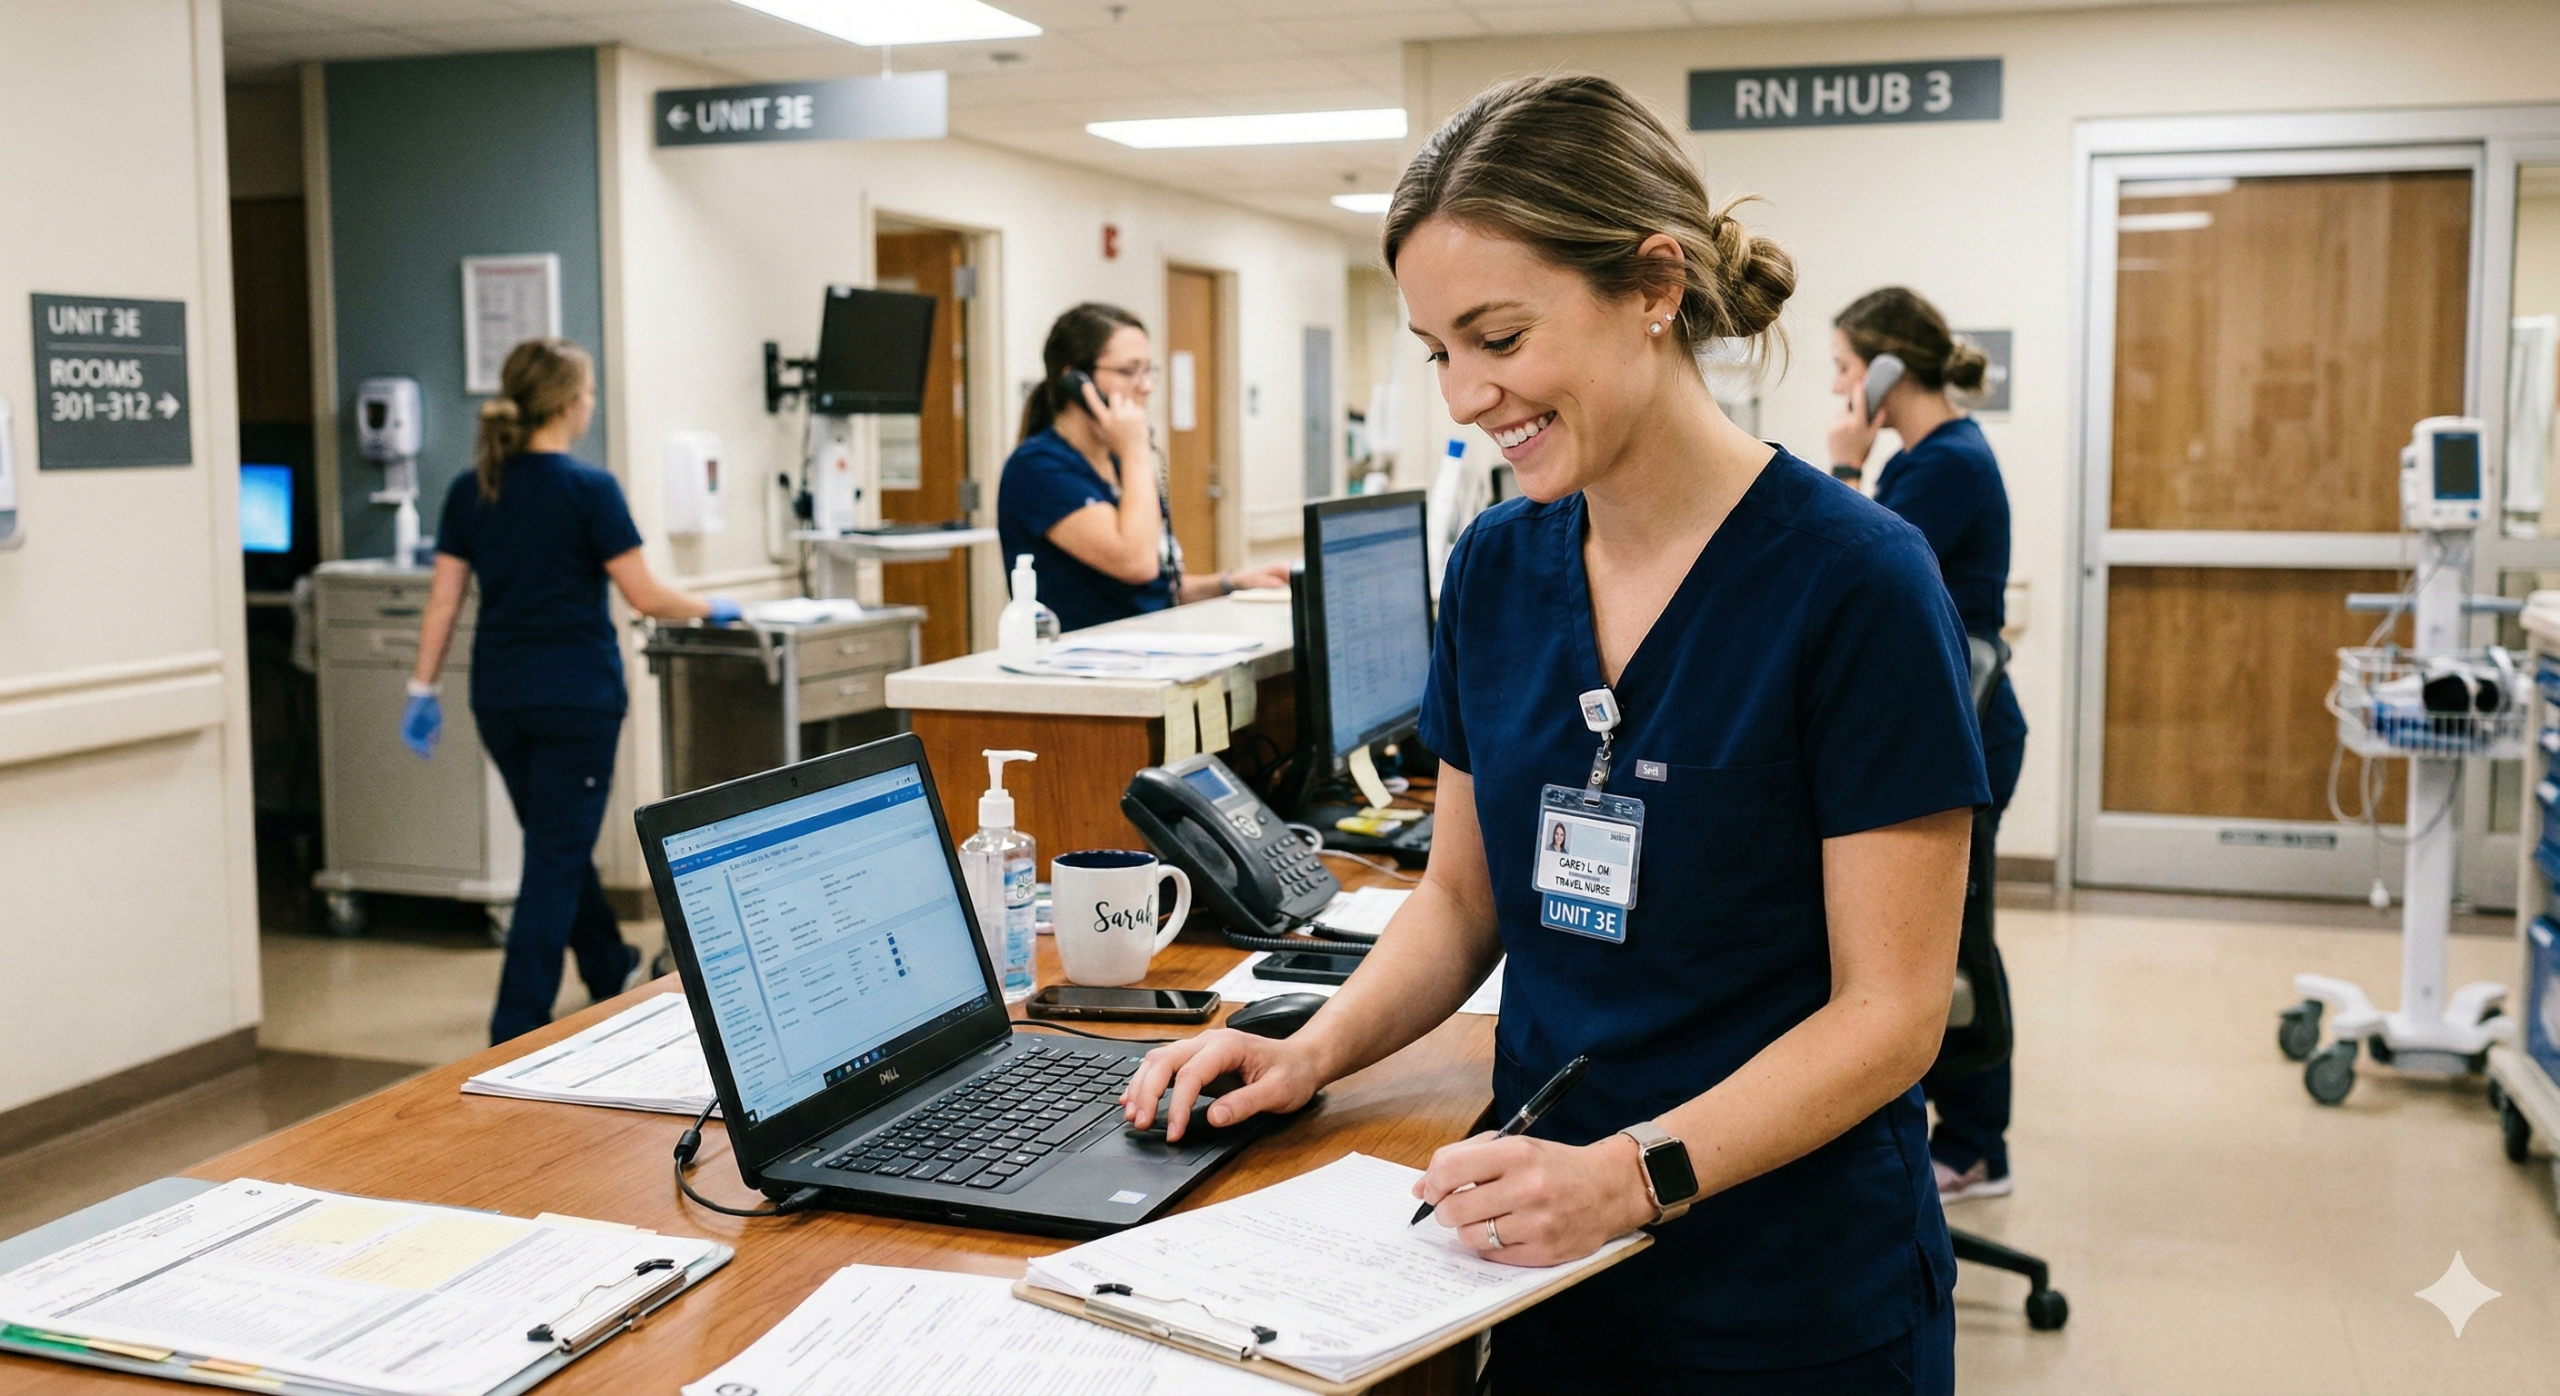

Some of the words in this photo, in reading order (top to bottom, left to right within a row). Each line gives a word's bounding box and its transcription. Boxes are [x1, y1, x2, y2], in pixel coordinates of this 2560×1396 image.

[1735, 76, 1799, 119] RN
[1812, 71, 1911, 118] HUB
[1923, 69, 1953, 113] 3
[696, 97, 771, 133] UNIT
[774, 94, 814, 130] 3E
[48, 305, 107, 336] UNIT
[110, 307, 142, 338] 3E
[50, 357, 143, 389] ROOMS
[1584, 881, 1611, 896] NURSE
[1093, 894, 1154, 933] Sarah
[1549, 900, 1591, 927] UNIT
[1594, 910, 1617, 934] 3E
